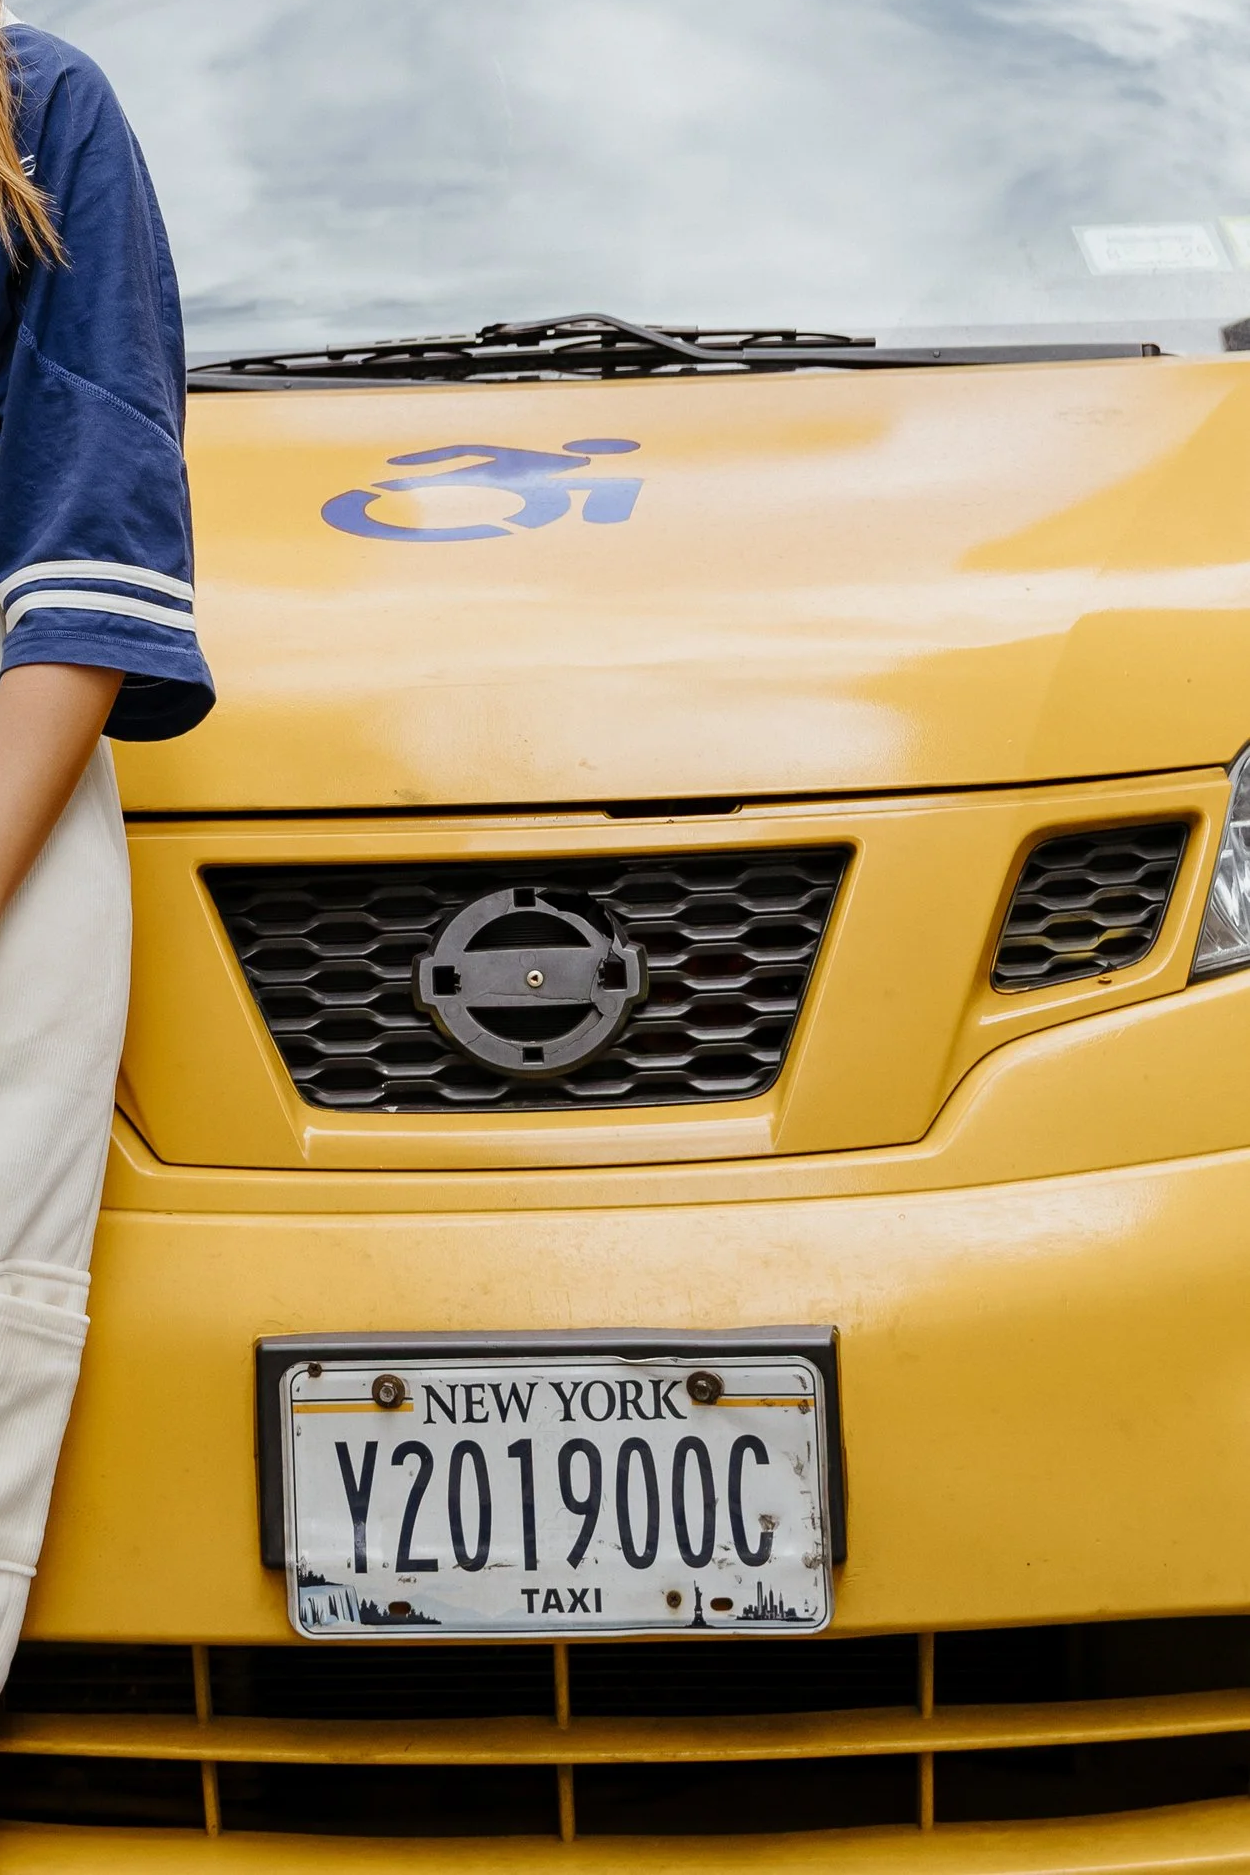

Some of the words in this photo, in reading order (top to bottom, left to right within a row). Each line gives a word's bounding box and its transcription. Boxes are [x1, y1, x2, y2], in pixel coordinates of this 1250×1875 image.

[422, 1381, 538, 1424] NEW
[548, 1379, 688, 1422] YORK
[335, 1434, 774, 1574] Y201900C
[520, 1587, 603, 1614] TAXI
